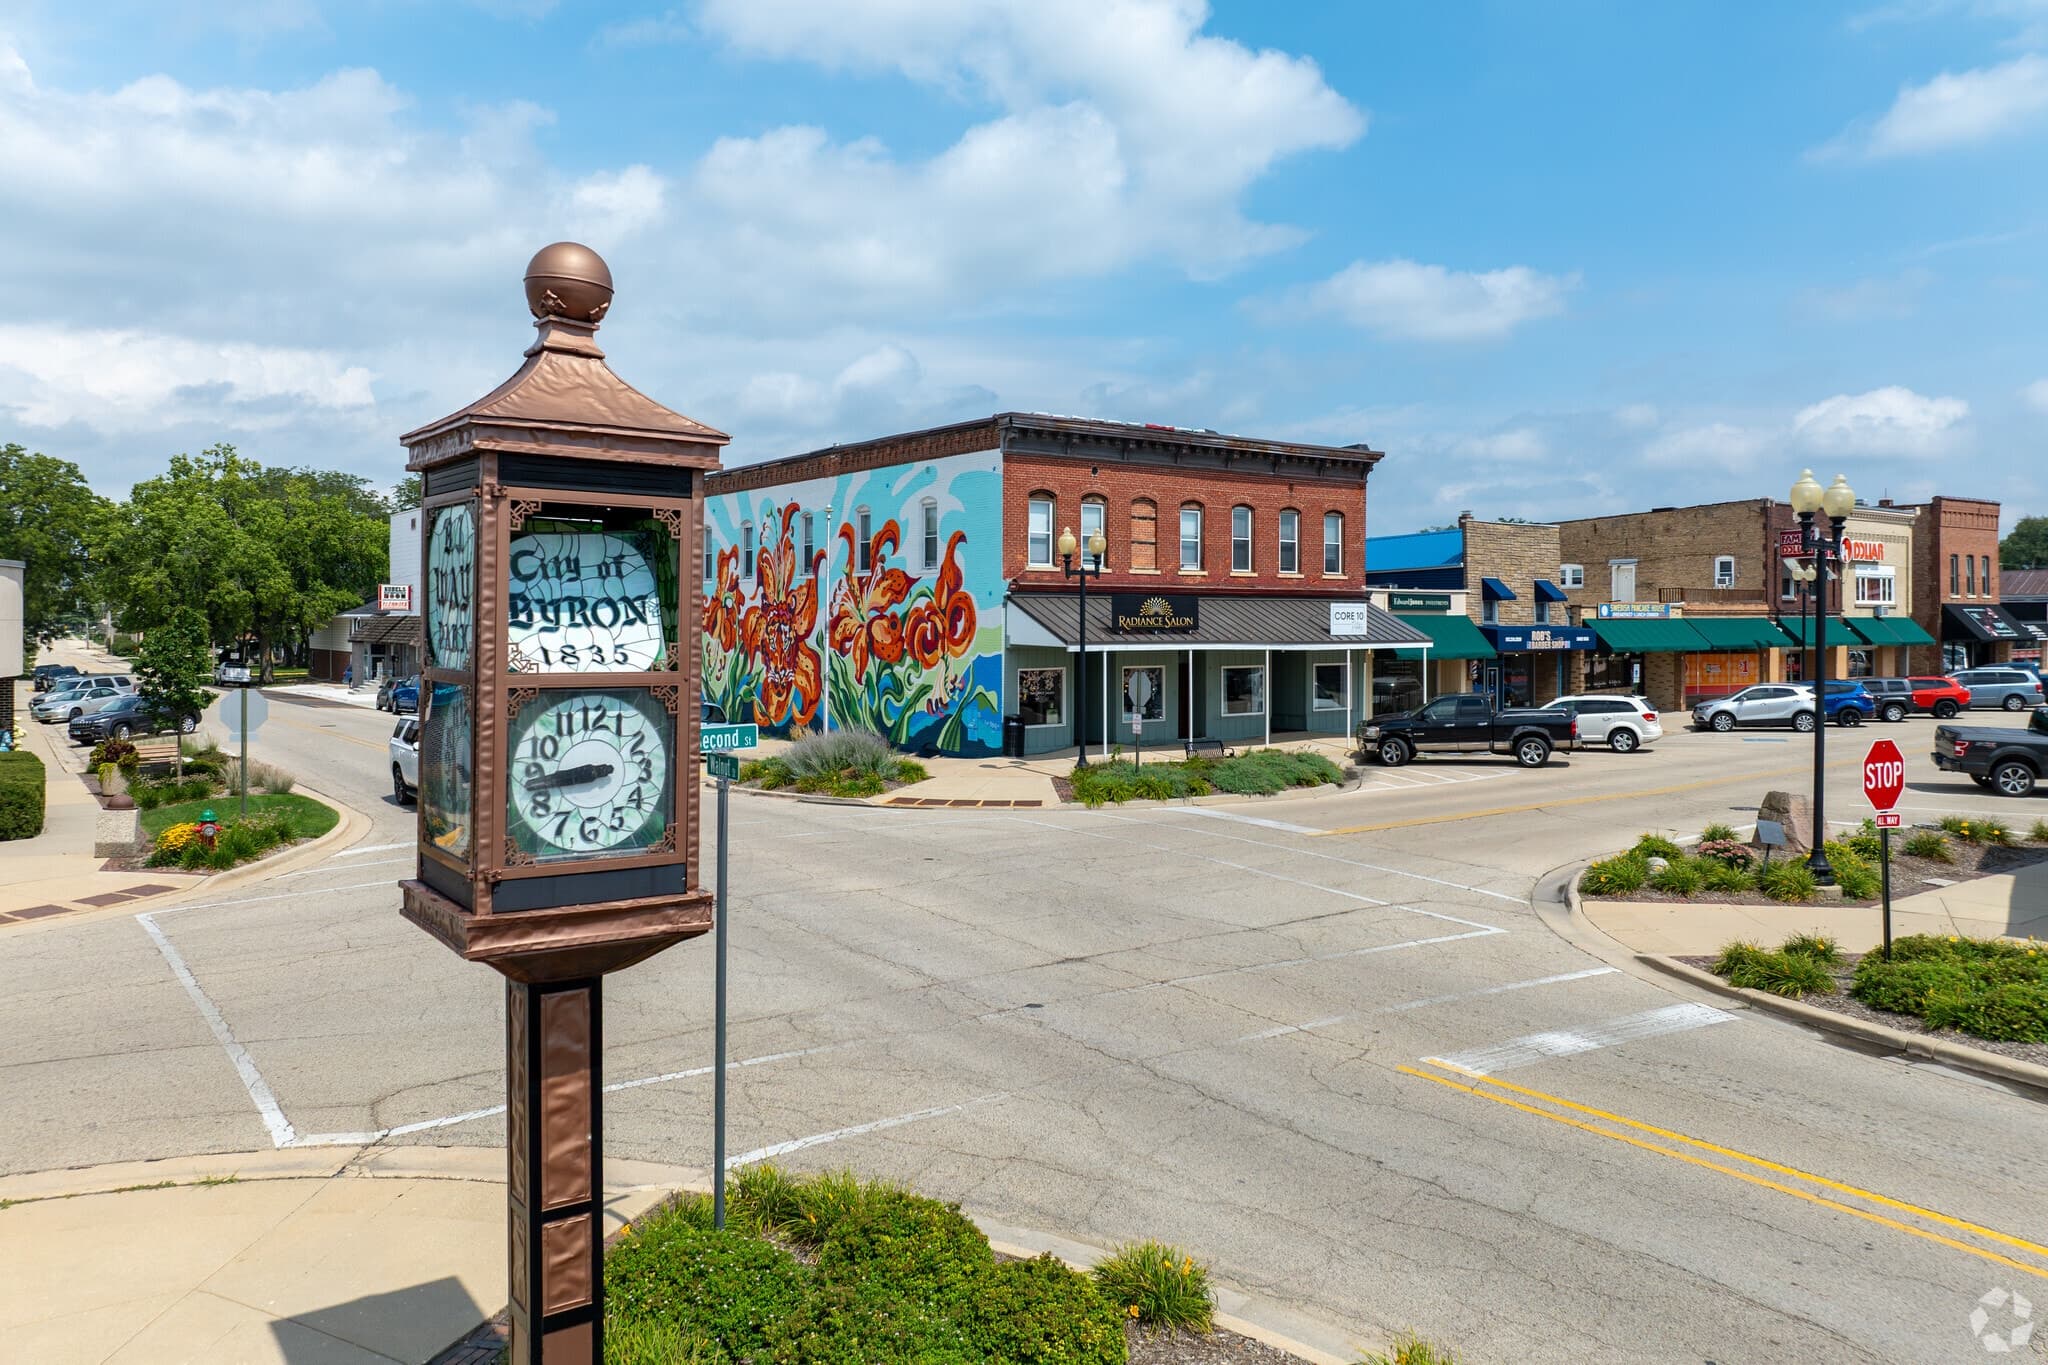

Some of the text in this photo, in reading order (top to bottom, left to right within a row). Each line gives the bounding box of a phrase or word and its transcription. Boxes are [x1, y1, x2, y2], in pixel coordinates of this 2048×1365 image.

[510, 550, 581, 582] City
[509, 592, 649, 633] BYRON
[1119, 616, 1193, 630] RADIANCE SALON
[1334, 611, 1364, 621] CORE 10
[540, 644, 629, 666] 1835
[556, 711, 574, 737] 11
[582, 704, 611, 731] 12
[531, 735, 559, 760] 10
[701, 728, 752, 749] econd St
[1866, 761, 1902, 790] STOP
[554, 811, 573, 837] 7
[579, 816, 599, 843] 6
[609, 806, 625, 831] 5
[1887, 816, 1898, 825] WAY
